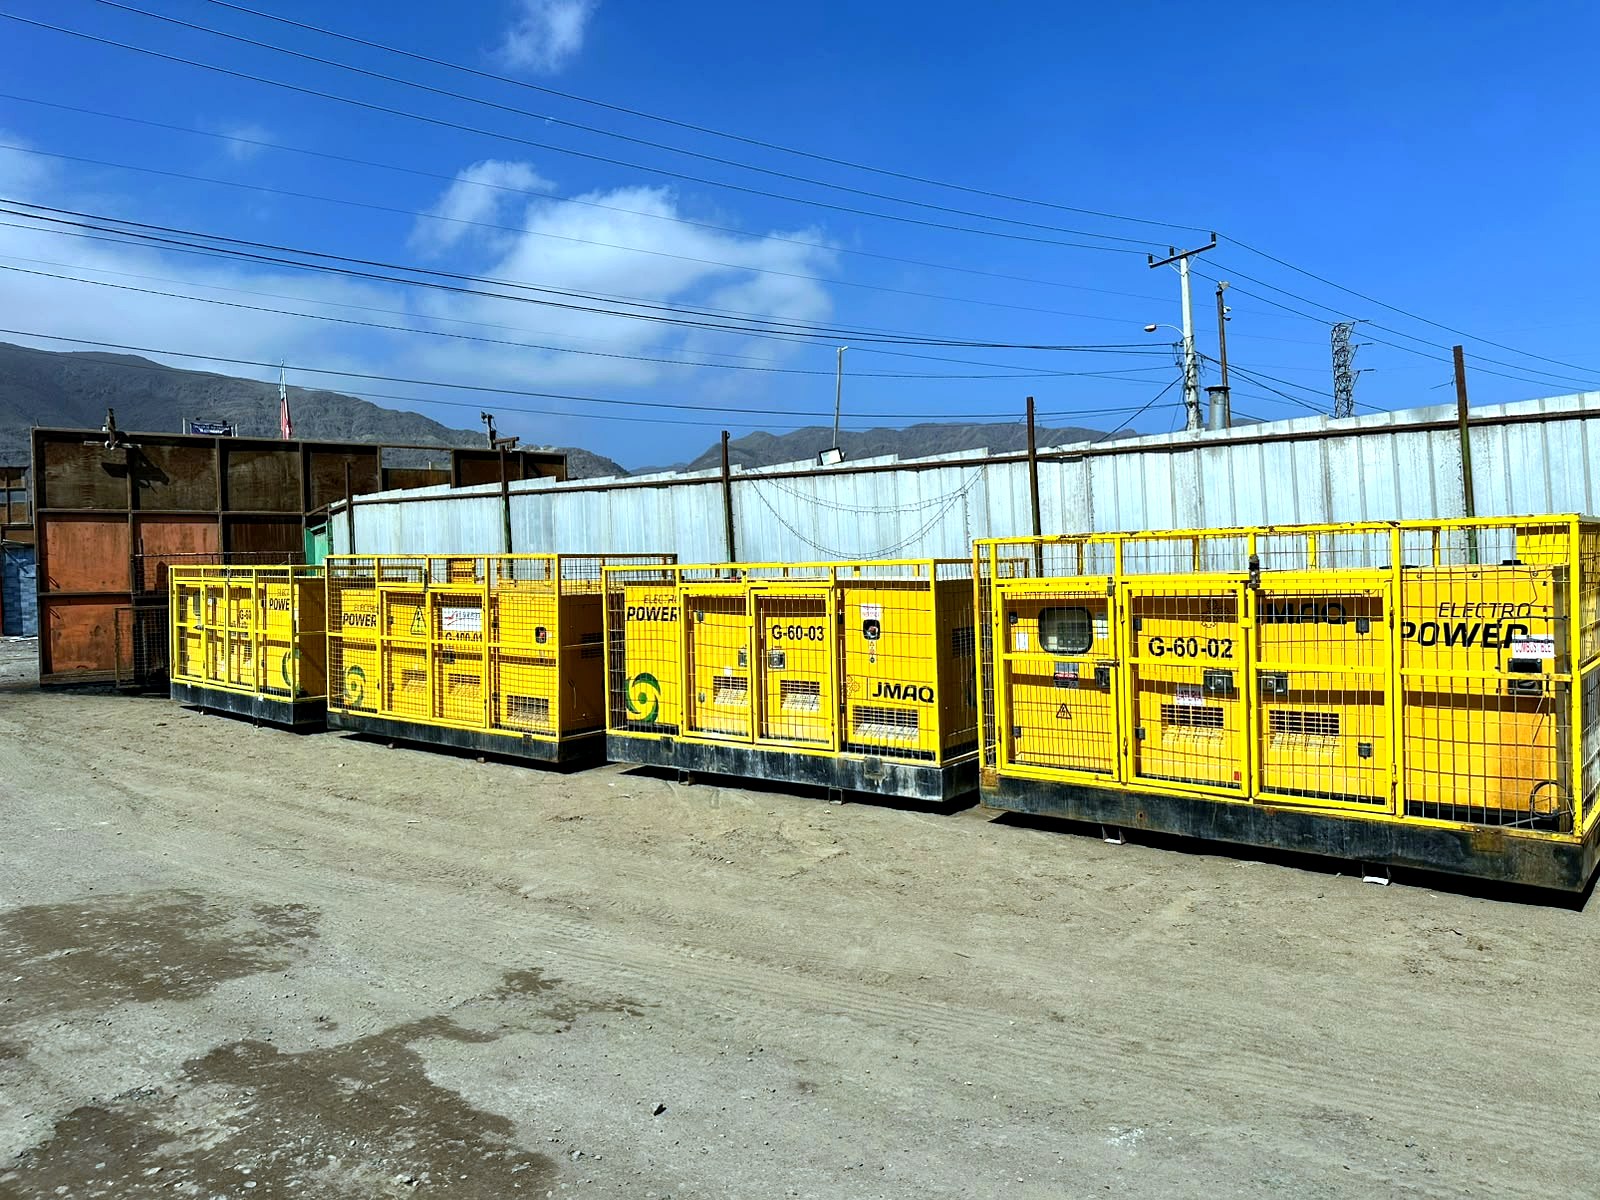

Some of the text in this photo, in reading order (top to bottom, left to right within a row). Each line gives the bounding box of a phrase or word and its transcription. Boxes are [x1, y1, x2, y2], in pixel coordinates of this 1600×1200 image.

[269, 598, 290, 611] POWE
[643, 594, 677, 604] ELECTR
[1255, 602, 1347, 625] JMAQ
[1438, 602, 1531, 619] ELECTRO
[342, 612, 377, 627] POWER
[771, 624, 825, 642] G-60-03
[1149, 636, 1233, 658] G-60-02
[872, 681, 935, 704] JMAQ
